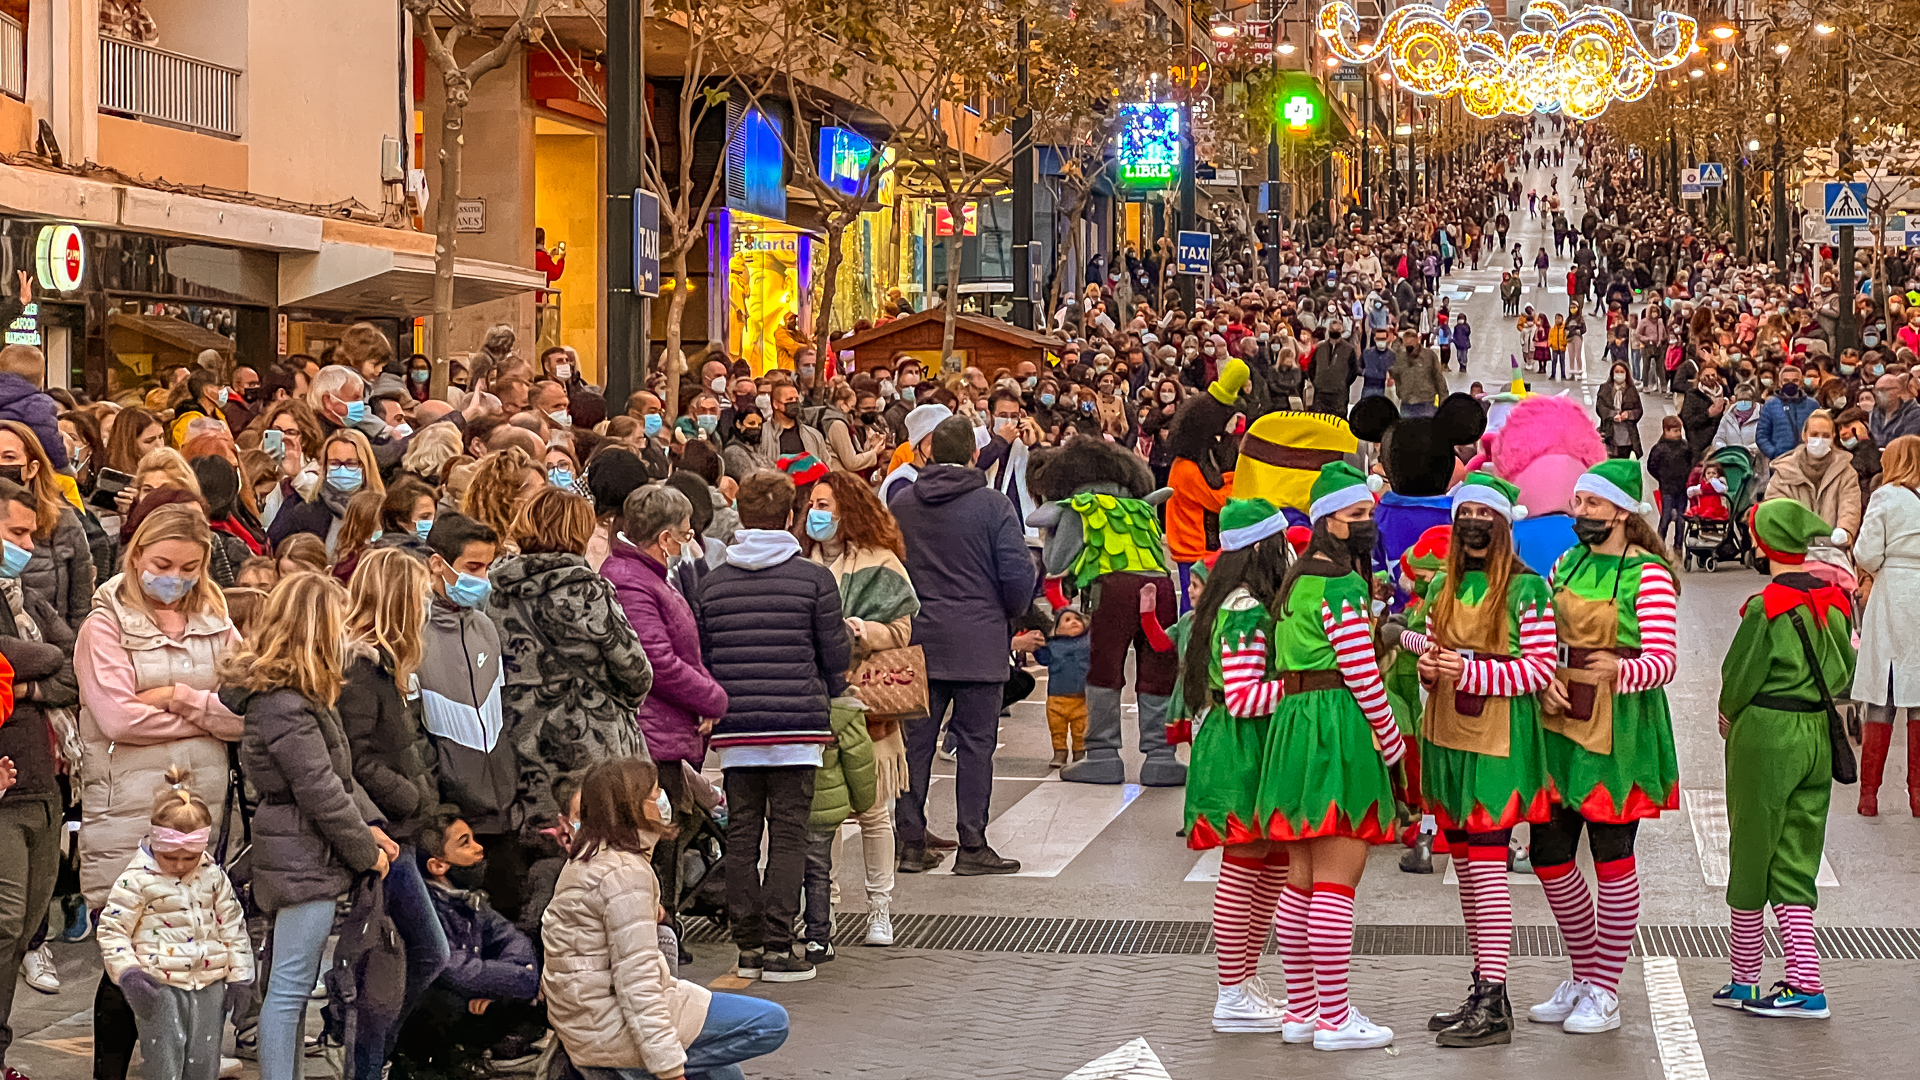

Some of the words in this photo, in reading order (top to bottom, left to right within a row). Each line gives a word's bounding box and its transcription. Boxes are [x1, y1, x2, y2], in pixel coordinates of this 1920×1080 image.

[1125, 164, 1170, 178] LIBRE
[640, 227, 660, 260] TAXI
[1180, 245, 1210, 260] TAXI
